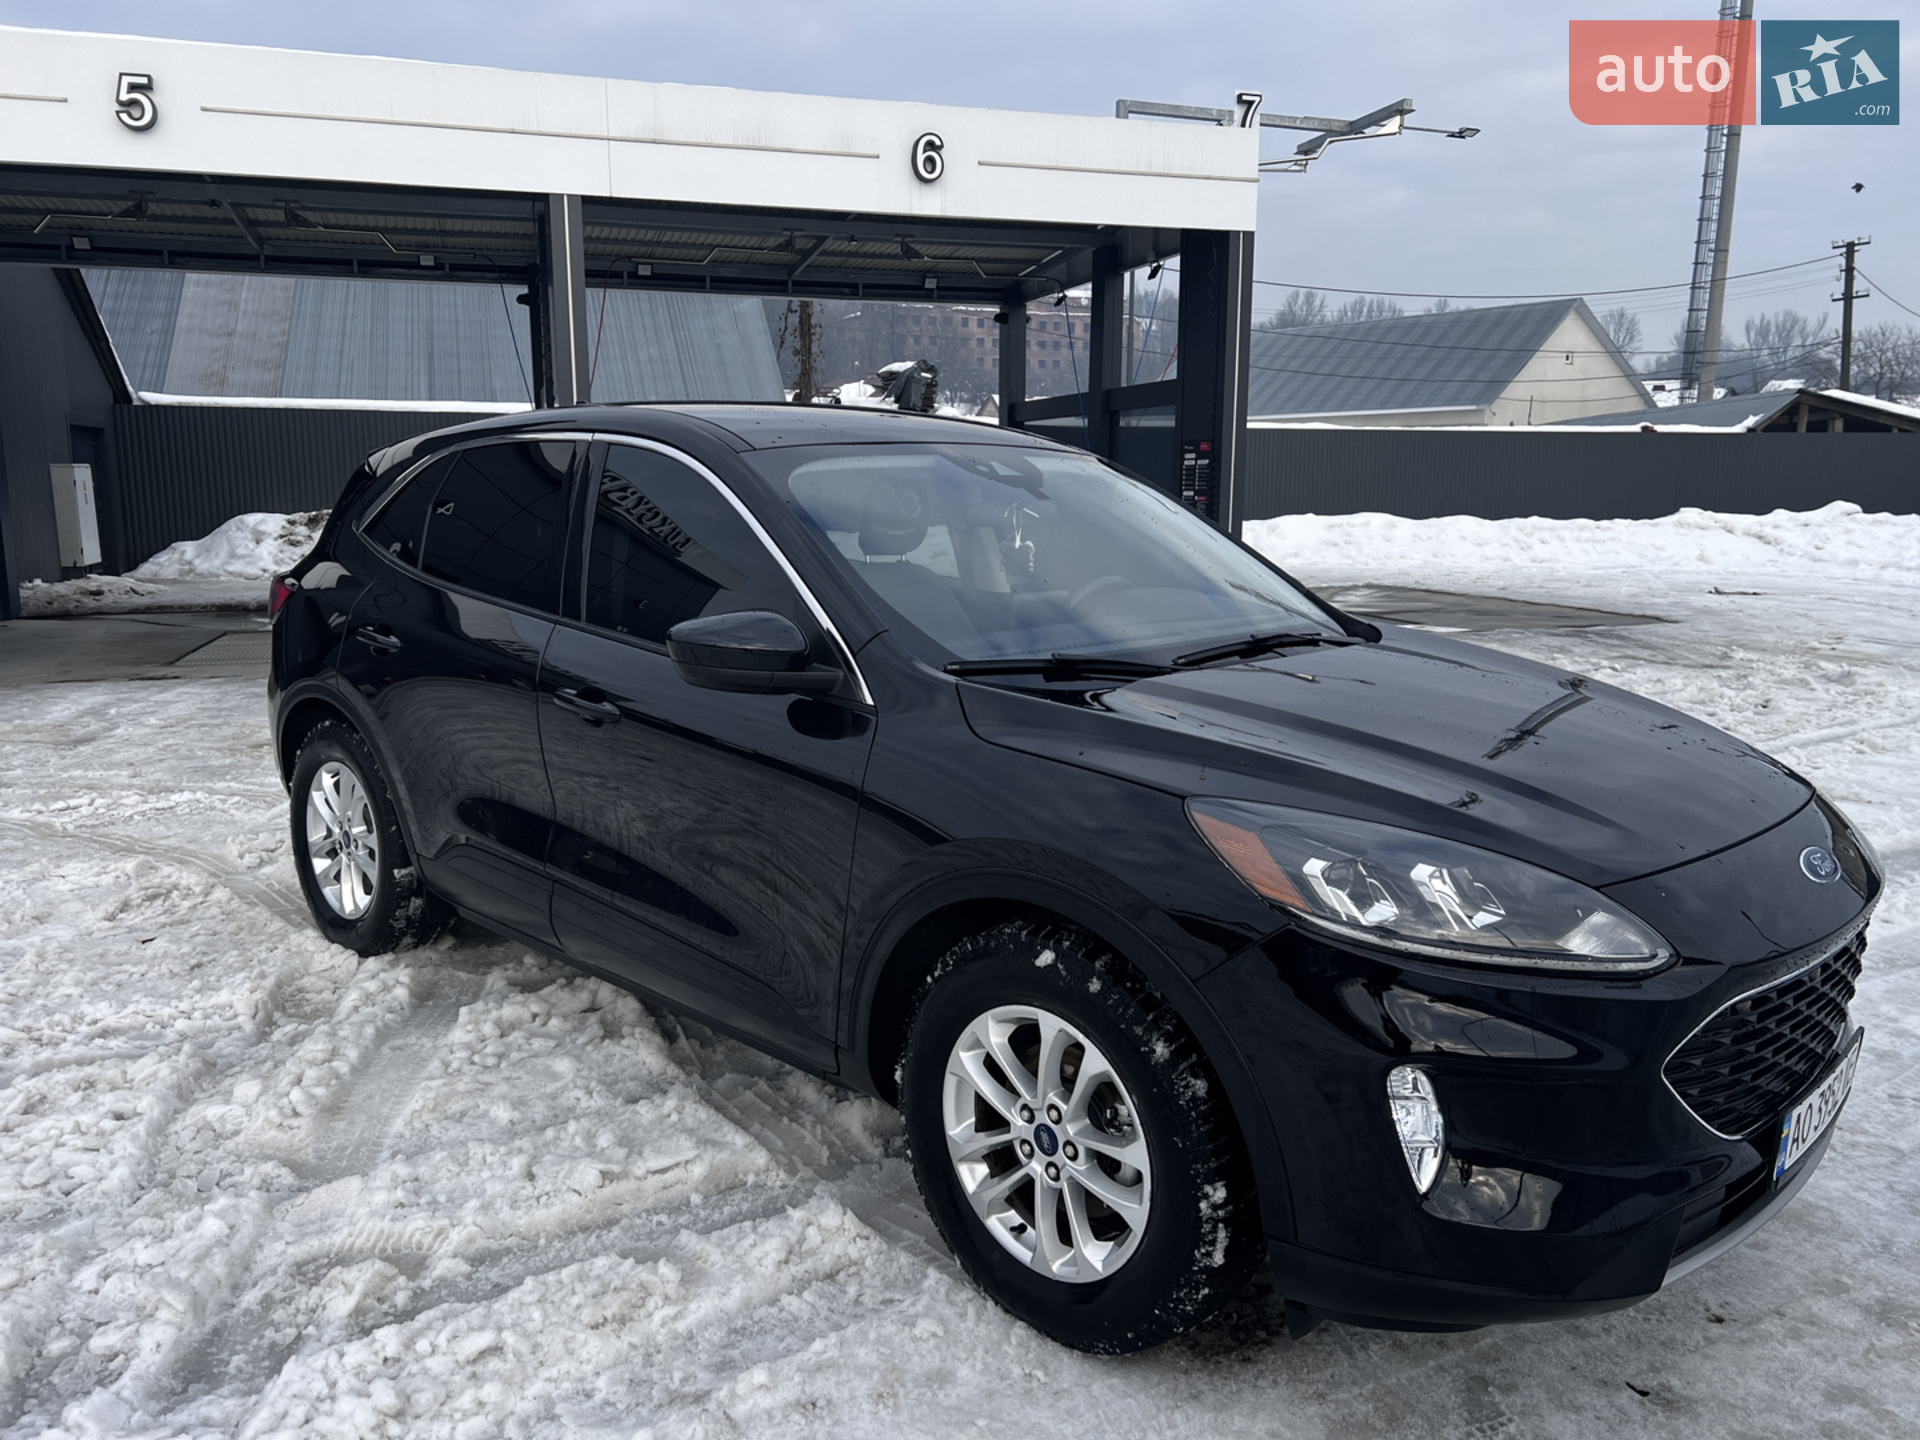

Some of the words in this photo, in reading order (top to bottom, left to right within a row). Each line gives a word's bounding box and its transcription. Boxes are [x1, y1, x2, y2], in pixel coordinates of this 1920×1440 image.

[115, 72, 158, 131] 5
[1237, 93, 1262, 128] 7
[911, 132, 944, 183] 6
[1788, 1103, 1813, 1159] AO
